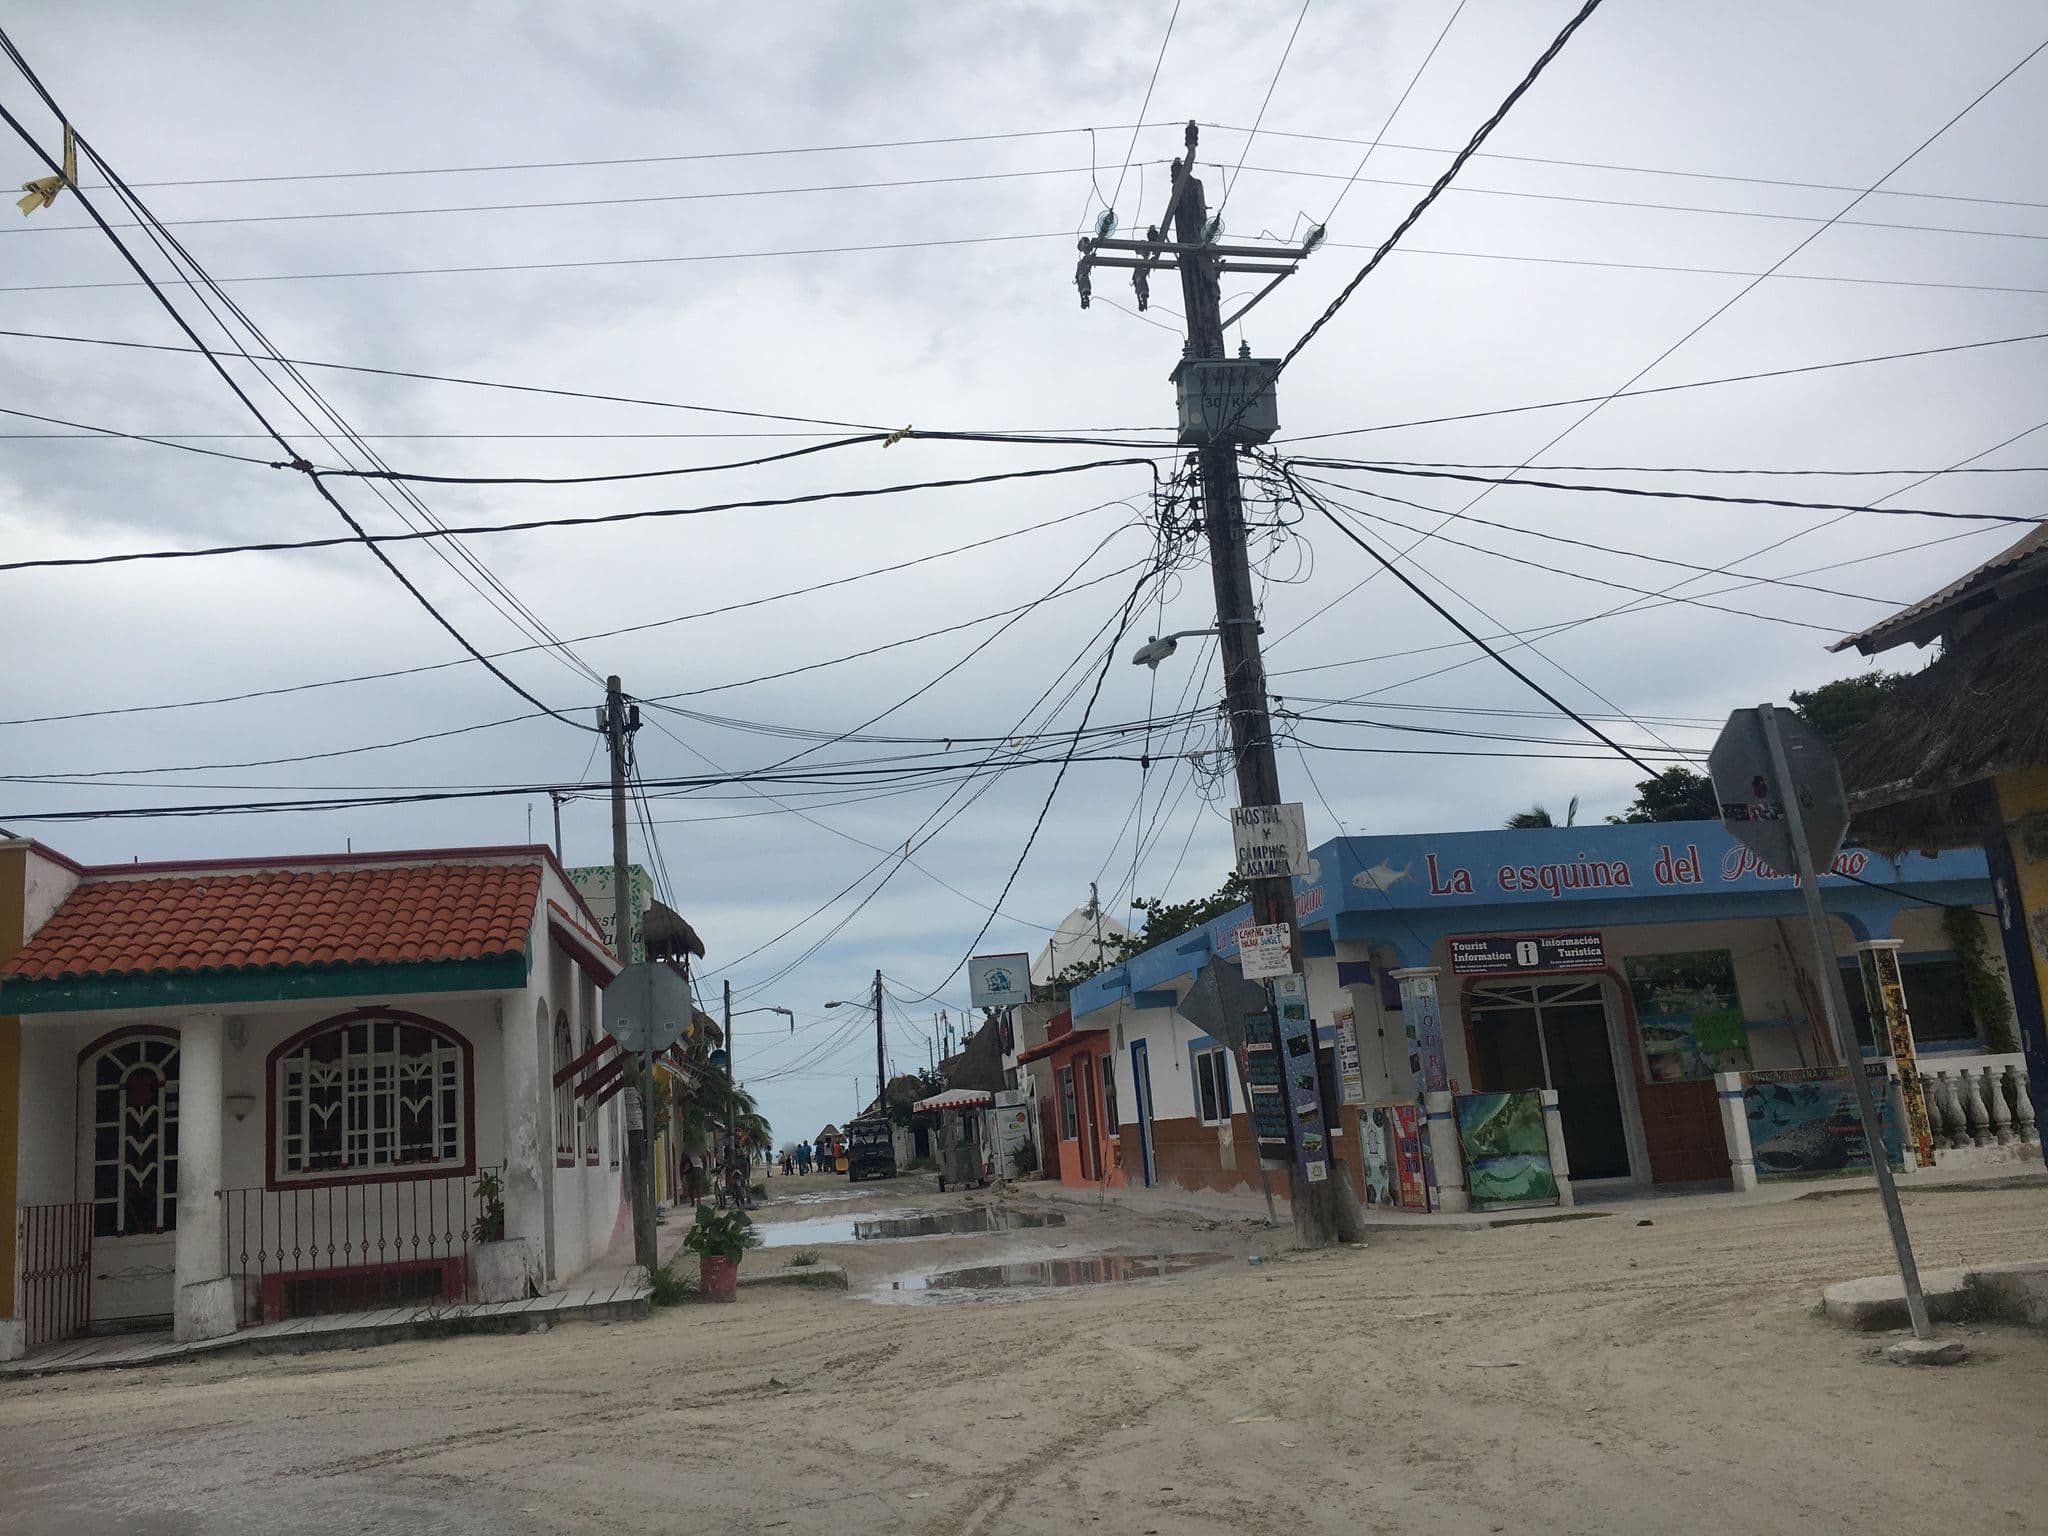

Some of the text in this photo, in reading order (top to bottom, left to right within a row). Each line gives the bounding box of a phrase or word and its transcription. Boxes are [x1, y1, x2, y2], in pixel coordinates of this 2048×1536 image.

[1204, 397, 1259, 408] 30 KA
[1425, 853, 1475, 896] La
[1498, 852, 1632, 899] esquina
[1653, 845, 1704, 887] del
[1452, 942, 1488, 951] Tourist
[1541, 936, 1600, 947] Información
[1454, 952, 1512, 962] Information
